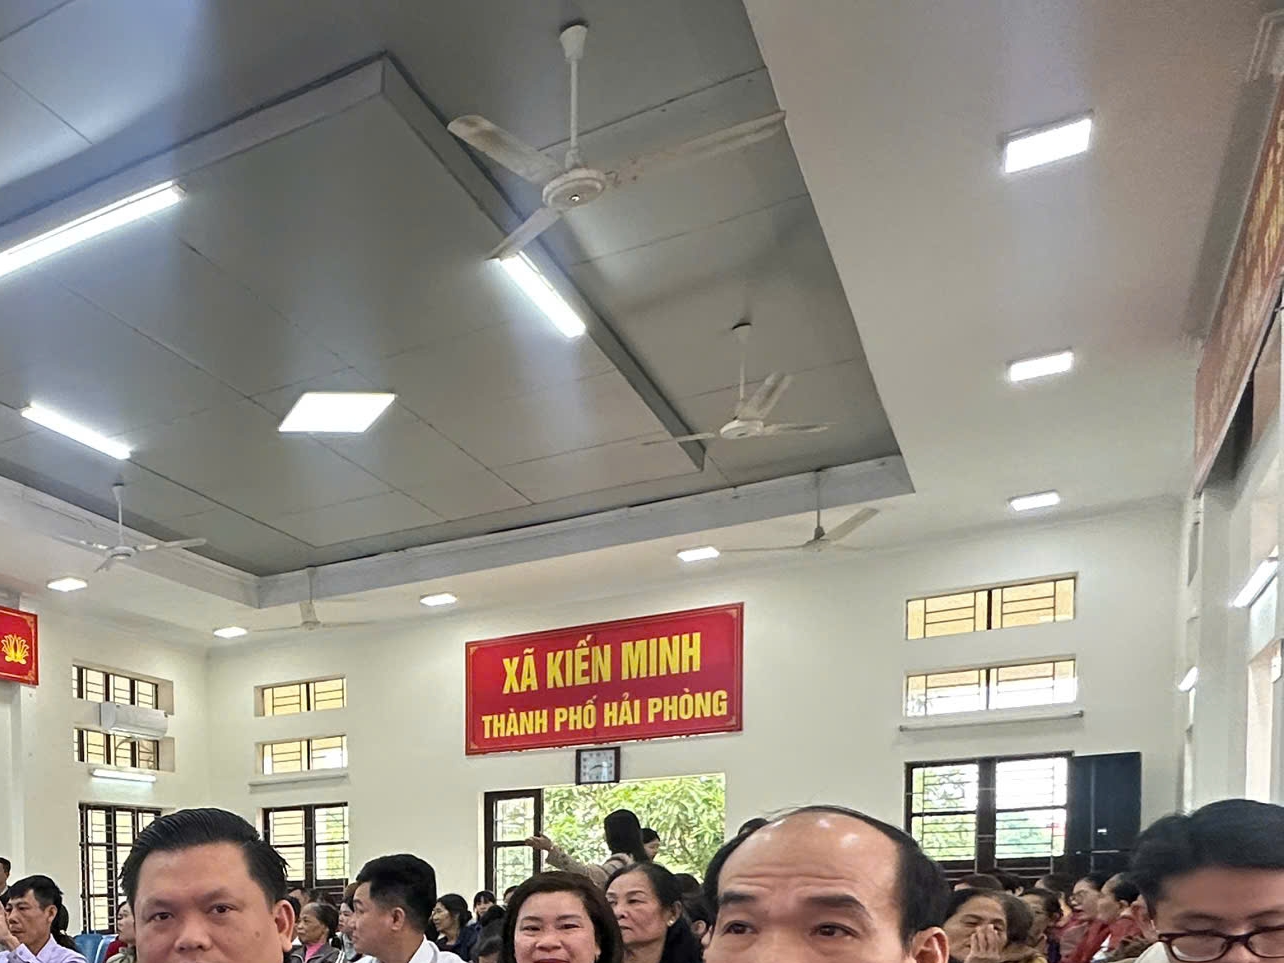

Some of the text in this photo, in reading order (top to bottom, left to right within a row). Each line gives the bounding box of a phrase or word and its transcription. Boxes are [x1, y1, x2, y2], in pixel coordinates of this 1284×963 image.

[503, 632, 701, 694] XÃ KIẾN MINH
[482, 688, 727, 737] THÀNH PHỐ HẢI PHÒNG
